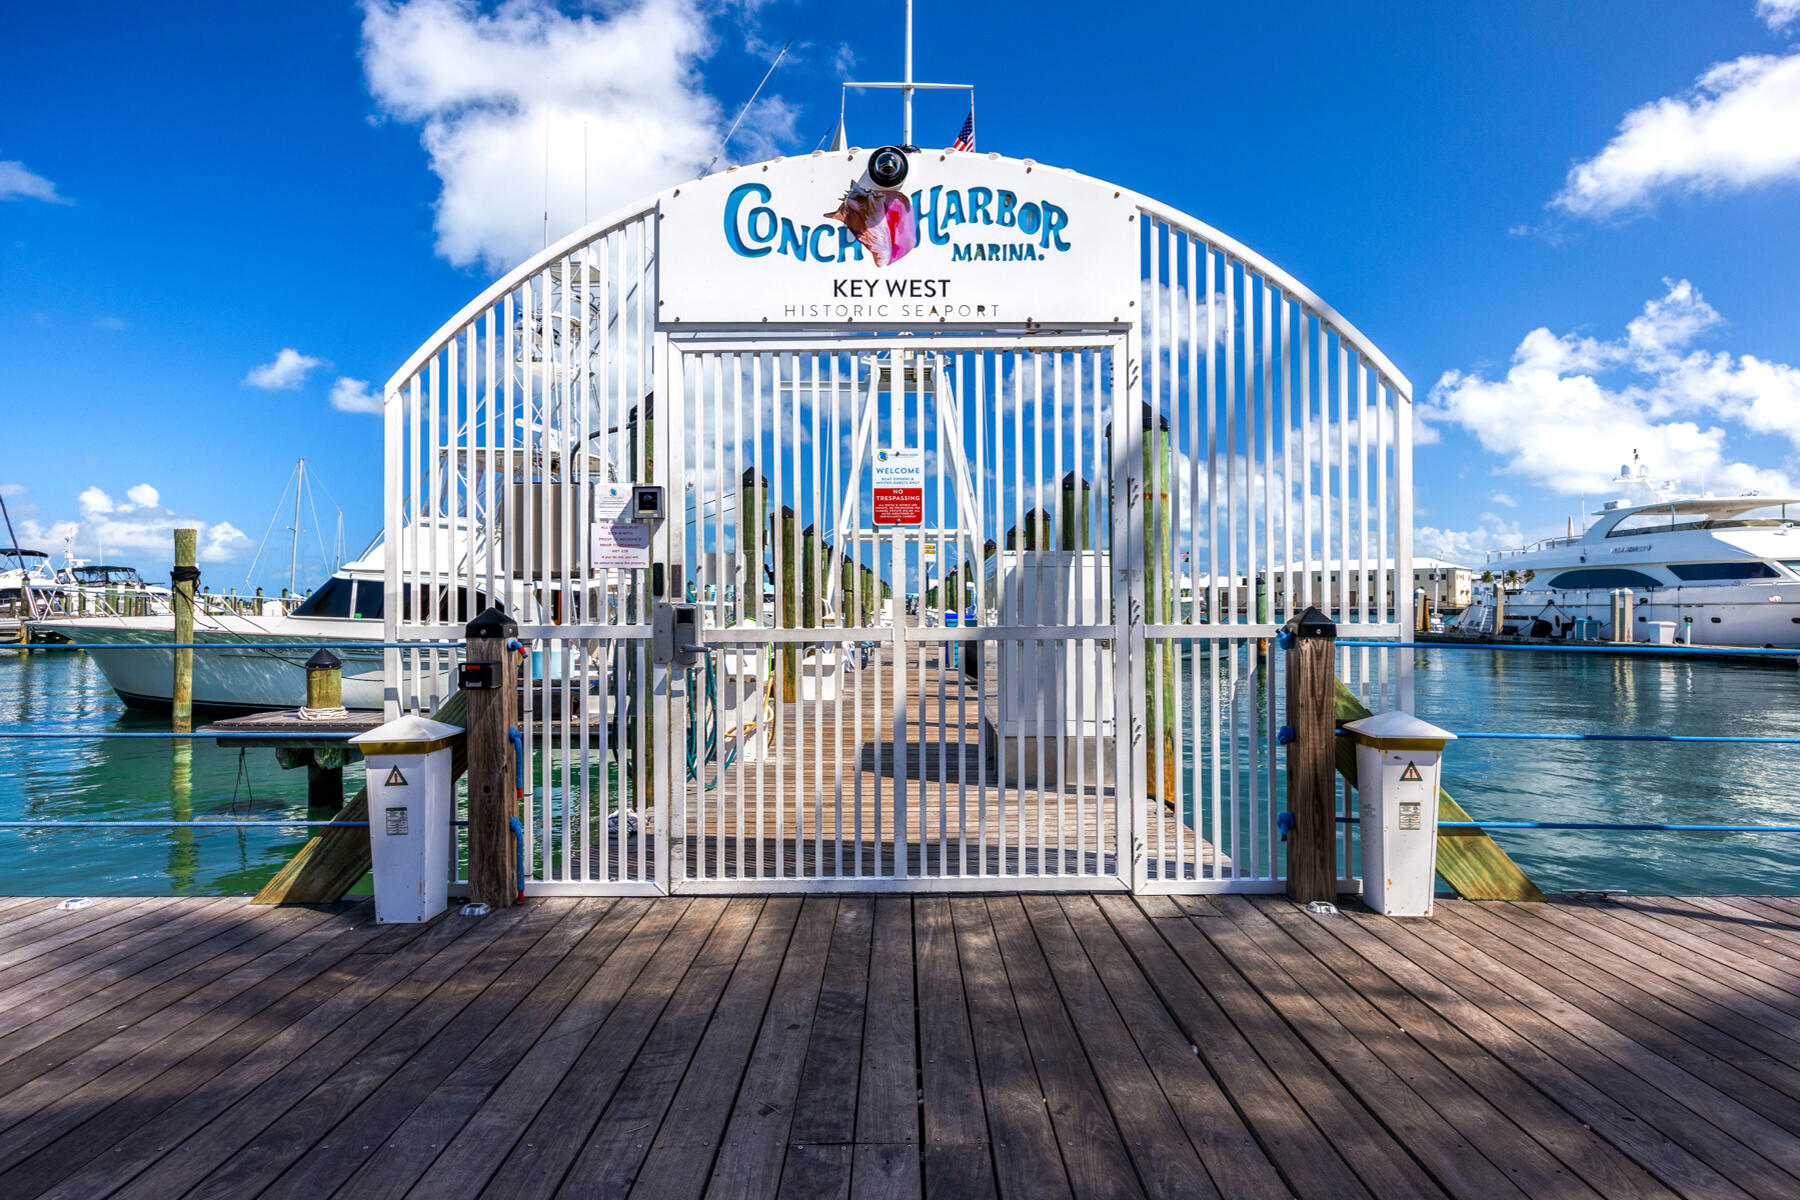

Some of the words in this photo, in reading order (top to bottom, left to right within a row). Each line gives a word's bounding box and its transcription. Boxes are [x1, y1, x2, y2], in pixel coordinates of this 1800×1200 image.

[724, 182, 864, 263] CONCH
[911, 184, 1071, 252] HARBOR
[833, 279, 879, 298] KEY
[885, 279, 951, 298] WEST
[784, 304, 889, 317] HISTORIC
[902, 304, 999, 317] SEAPORT
